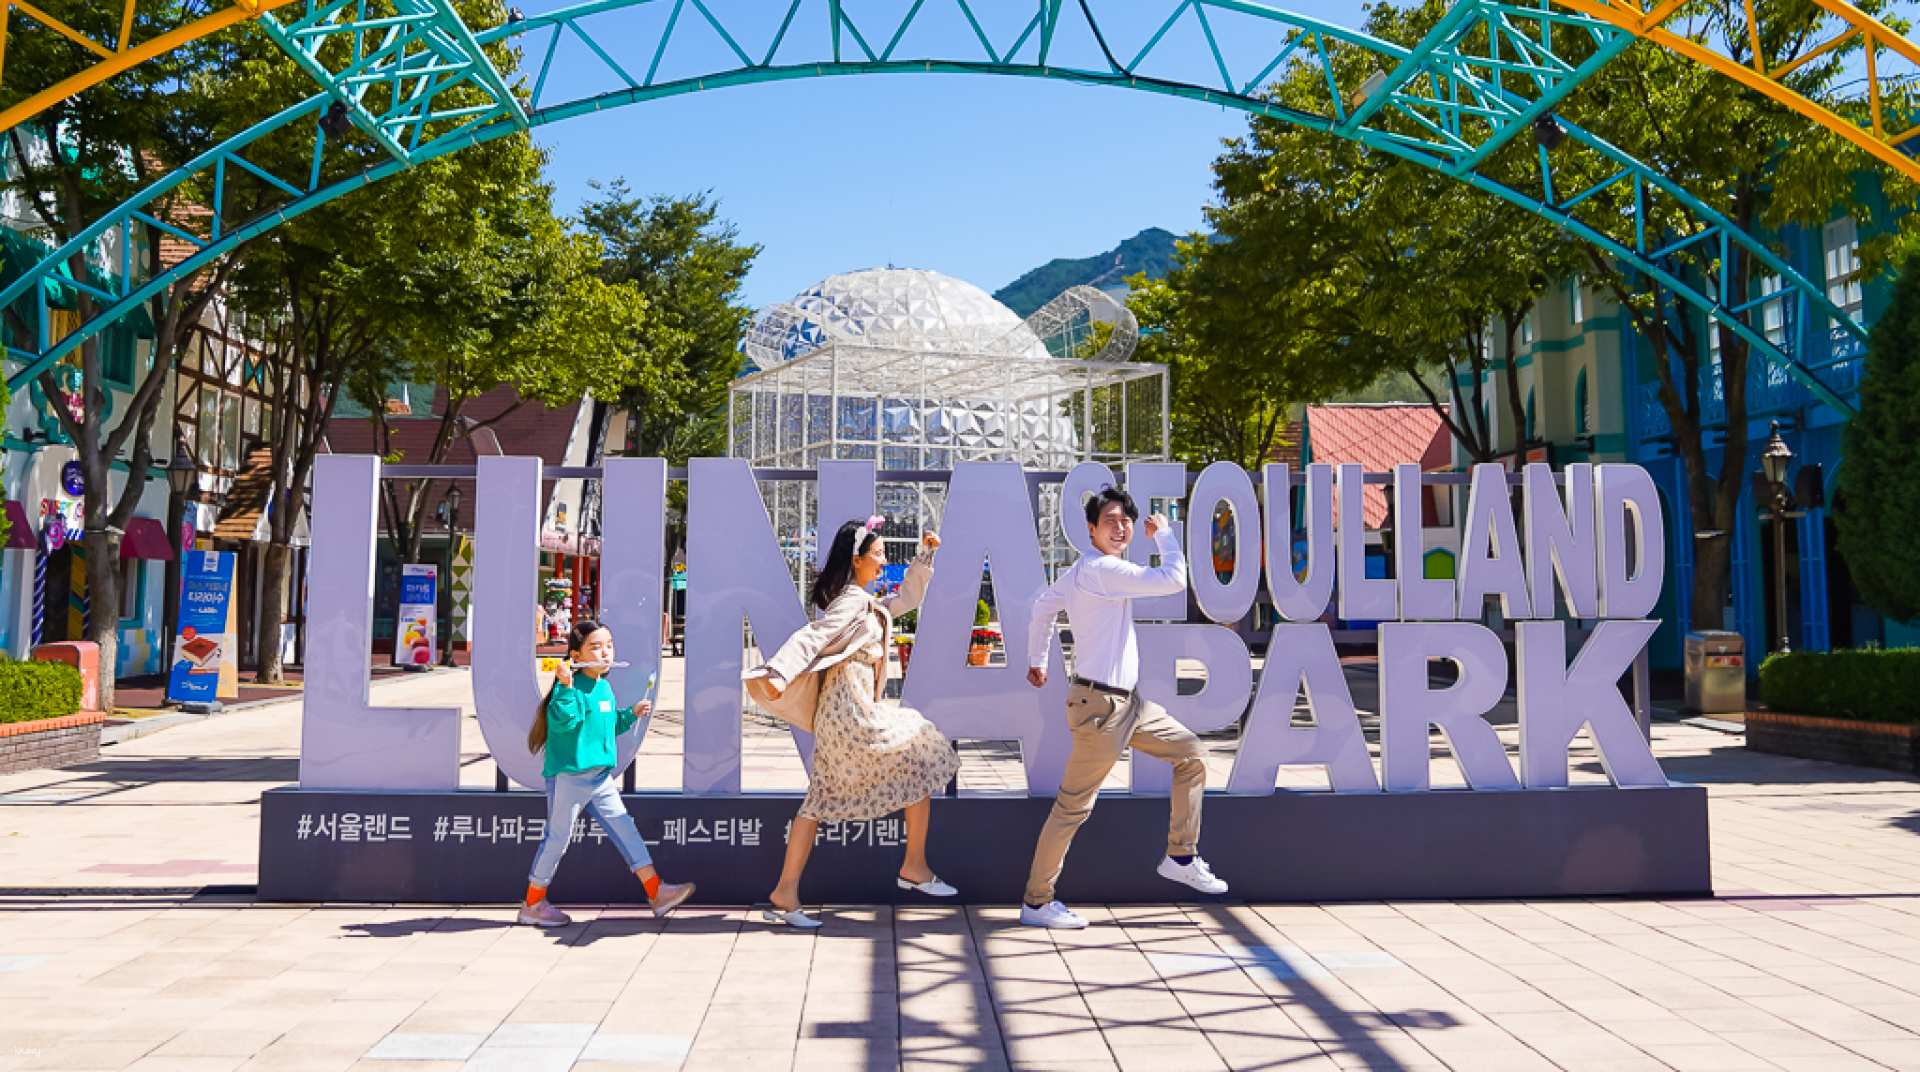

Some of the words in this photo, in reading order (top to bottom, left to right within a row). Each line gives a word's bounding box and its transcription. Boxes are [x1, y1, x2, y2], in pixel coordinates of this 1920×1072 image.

[299, 454, 1070, 797] LUNA
[1130, 619, 1669, 796] PARK
[296, 812, 413, 842] #서울랜드
[432, 814, 547, 844] #루나파크
[571, 816, 762, 846] #루_페스티발
